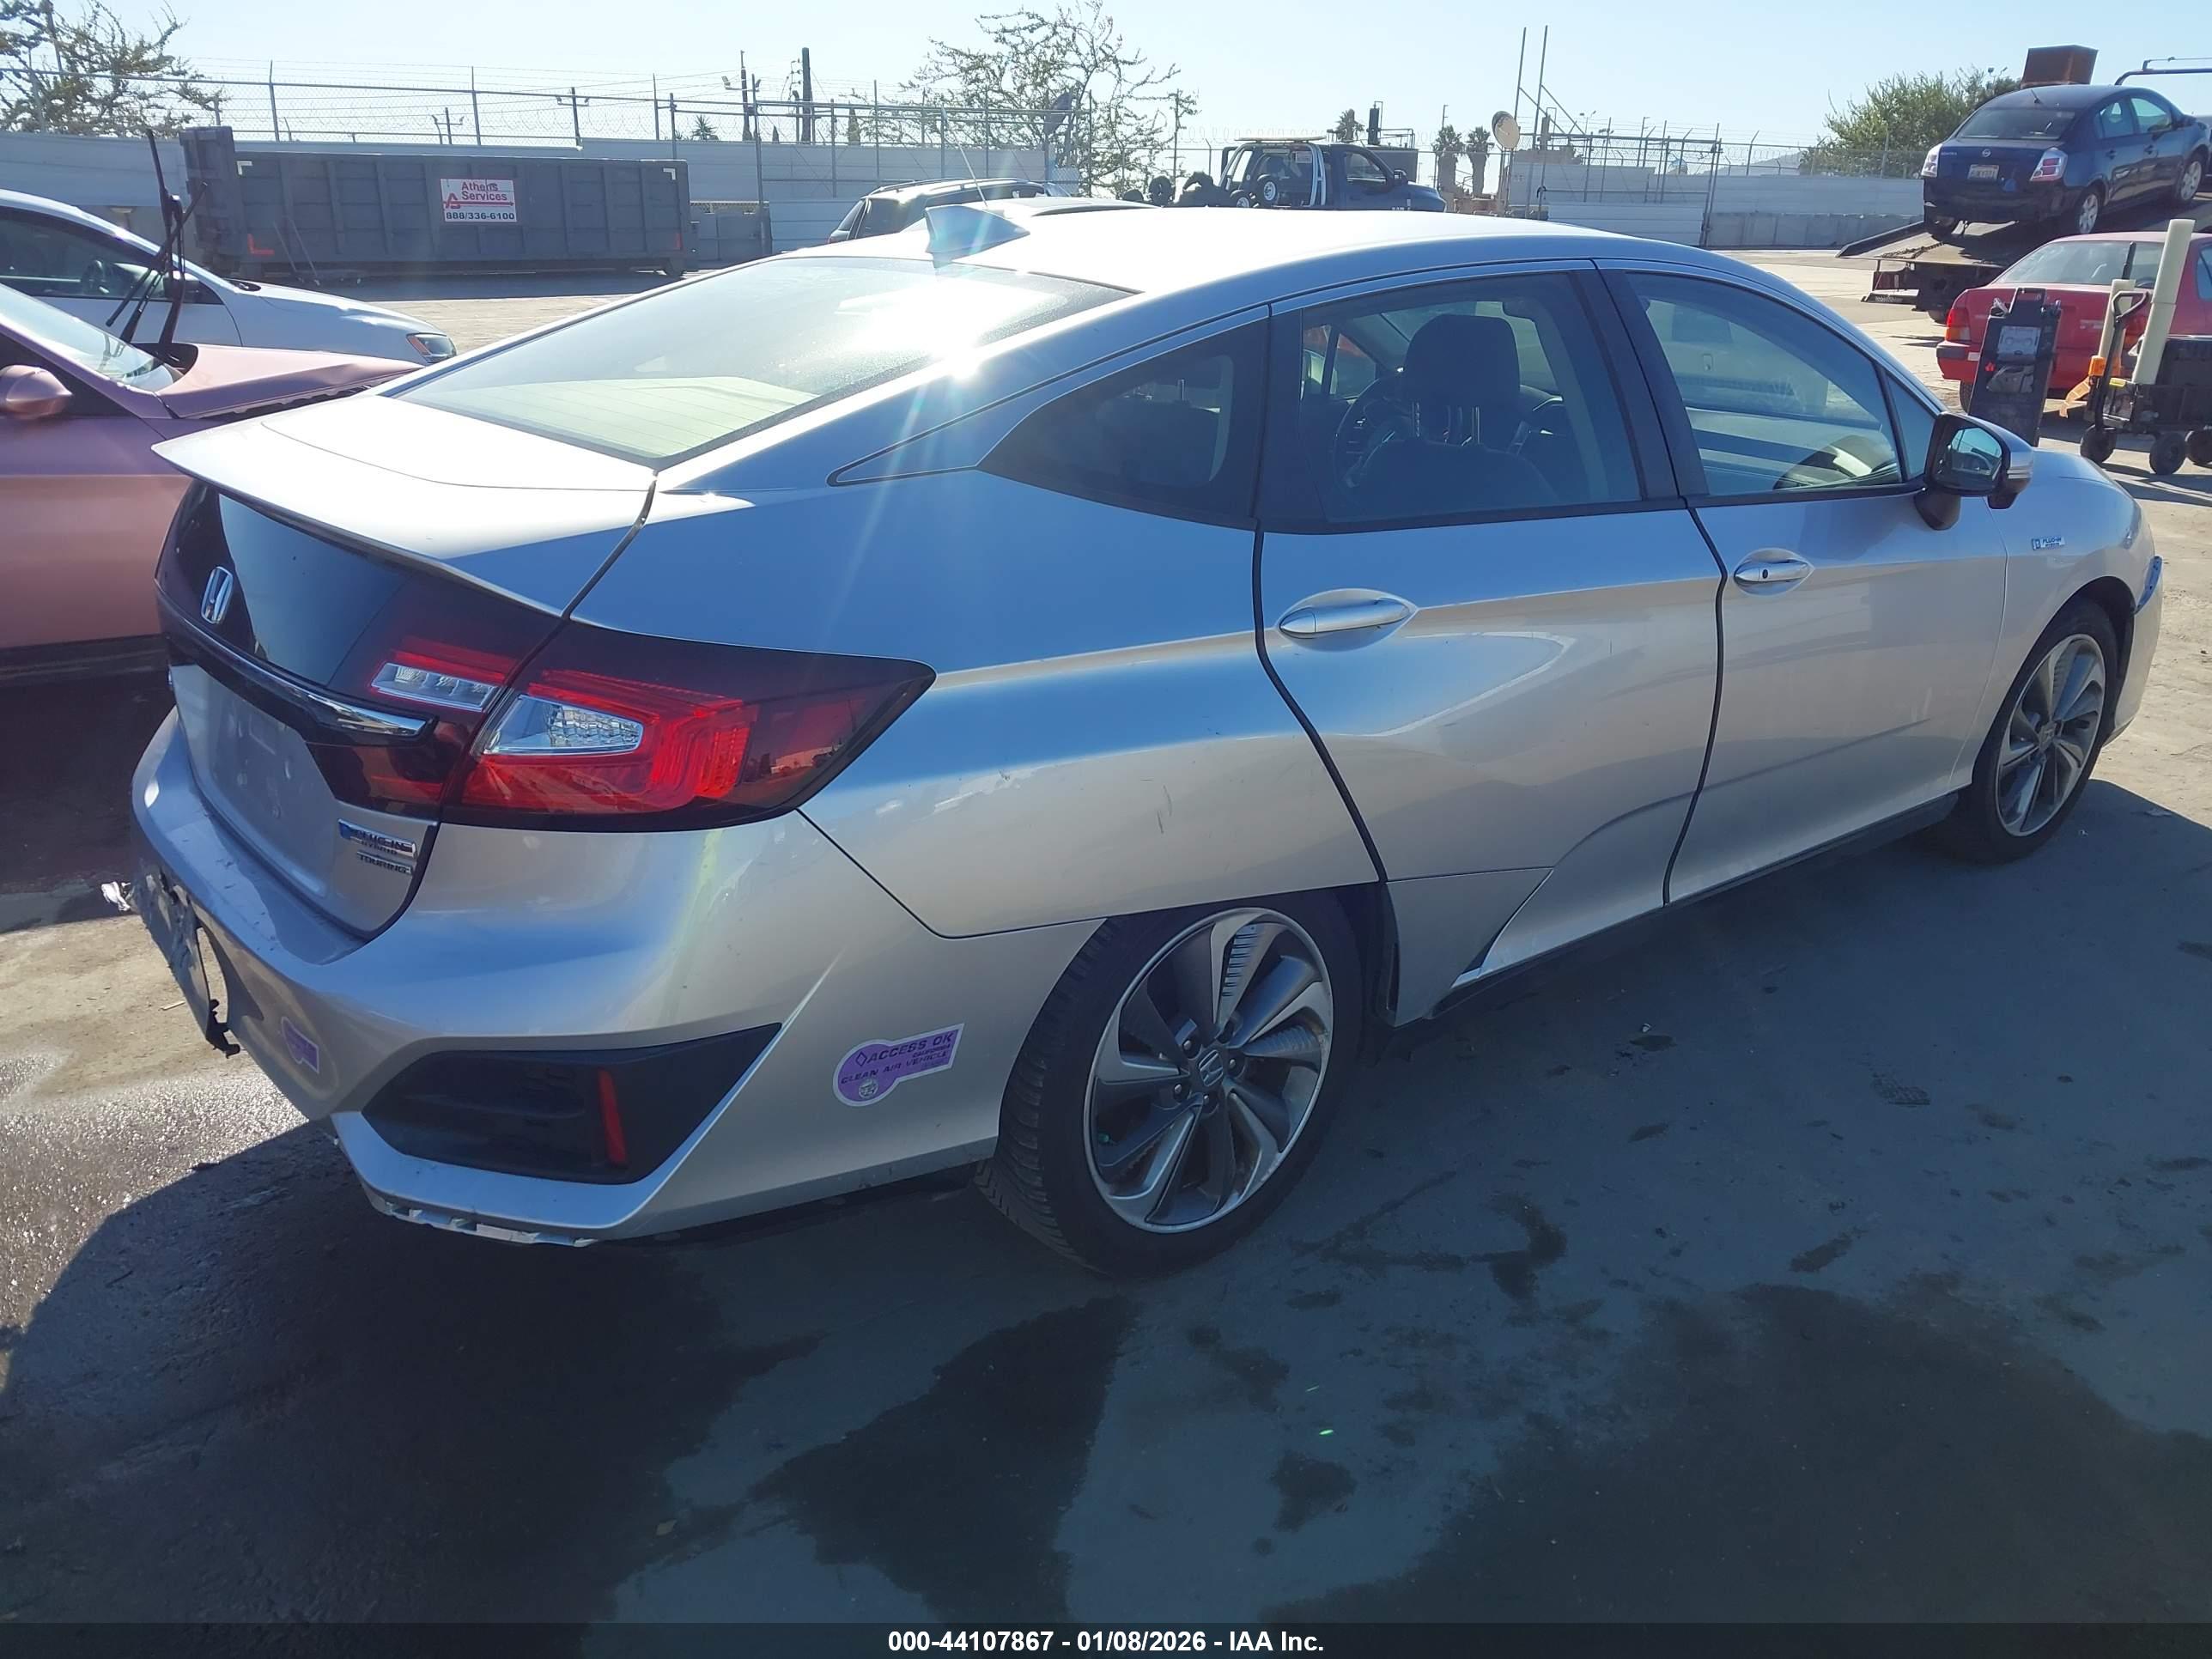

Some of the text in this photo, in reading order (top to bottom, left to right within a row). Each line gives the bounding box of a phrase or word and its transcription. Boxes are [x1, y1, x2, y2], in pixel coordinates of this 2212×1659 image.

[461, 181, 498, 191] Athens
[461, 191, 508, 201] Services
[446, 211, 515, 220] 888/336-6100
[359, 854, 408, 873] TOURING
[866, 1032, 954, 1064] ACCESS OK
[841, 1051, 947, 1085] CLEAN AIR VEHICLE
